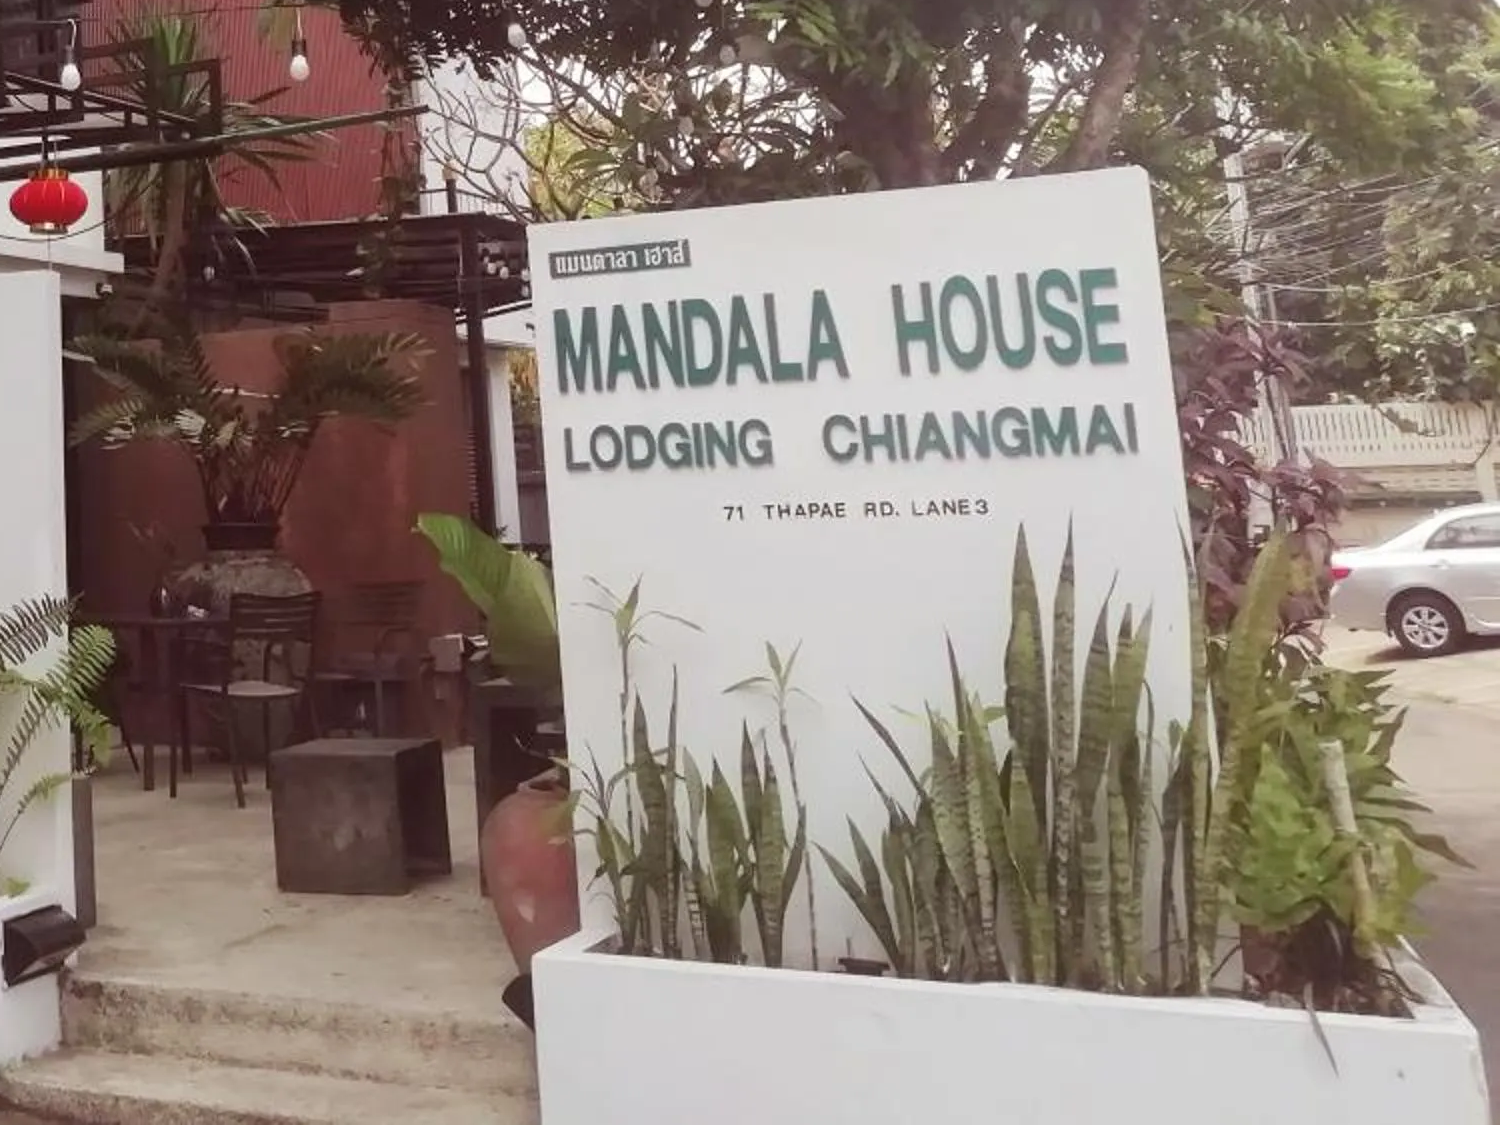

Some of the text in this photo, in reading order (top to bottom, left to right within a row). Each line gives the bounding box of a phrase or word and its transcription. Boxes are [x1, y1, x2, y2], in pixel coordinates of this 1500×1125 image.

[553, 267, 1128, 395] MANDALA HOUSE
[563, 401, 1139, 473] LODGING CHIANGMAI
[723, 505, 746, 522] 71
[762, 502, 847, 520] THAPAE
[864, 501, 902, 518] RD.
